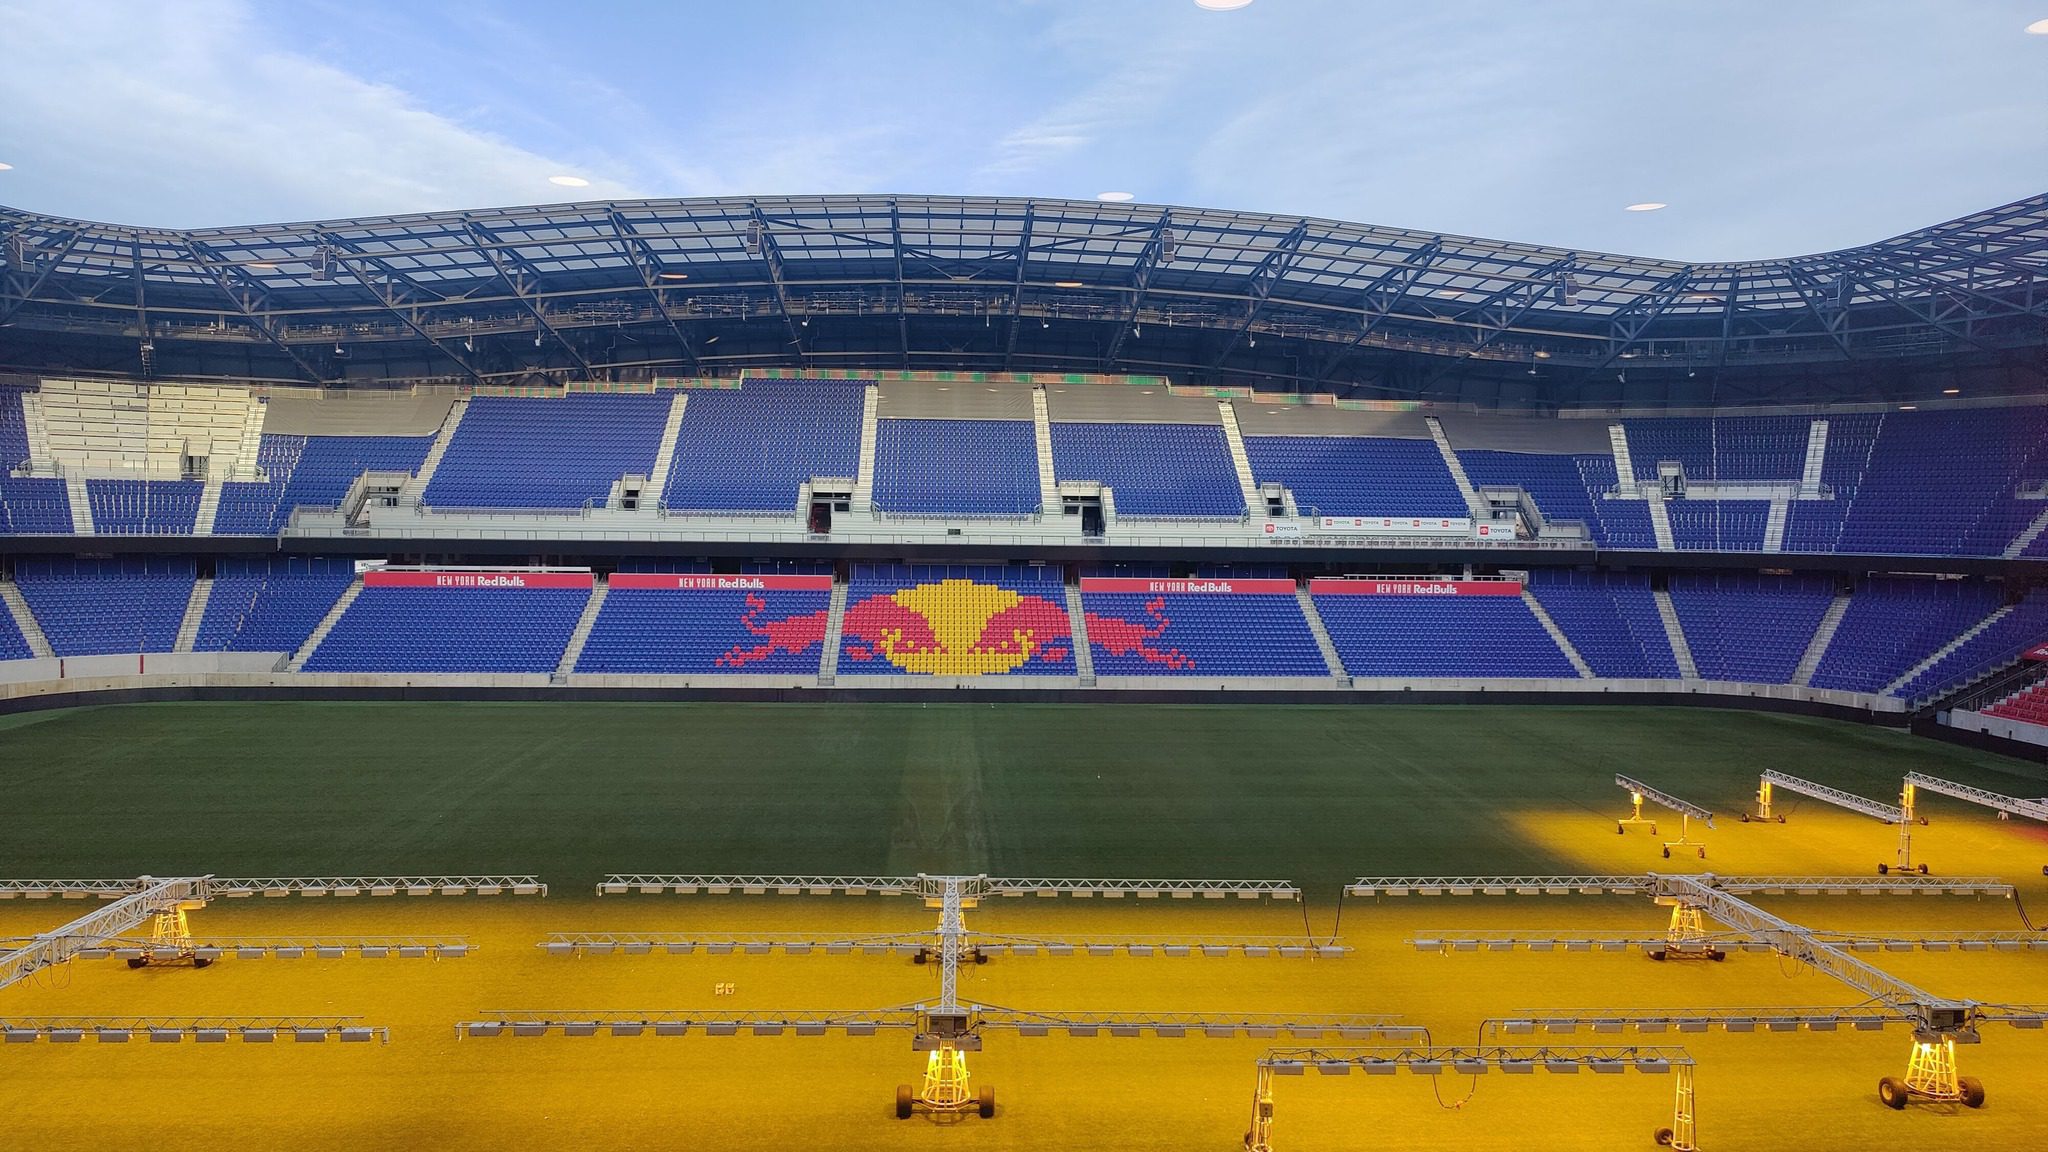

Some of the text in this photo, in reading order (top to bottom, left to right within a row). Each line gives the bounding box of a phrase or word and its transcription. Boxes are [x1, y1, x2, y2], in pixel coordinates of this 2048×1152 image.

[436, 576, 453, 586] NEW
[455, 576, 475, 586] YORK
[678, 578, 694, 588] NEW
[696, 578, 716, 588] YORK
[1149, 581, 1165, 592] NEW
[1166, 581, 1185, 592] YORK
[1376, 583, 1391, 594] NEW
[1392, 583, 1412, 594] YORK
